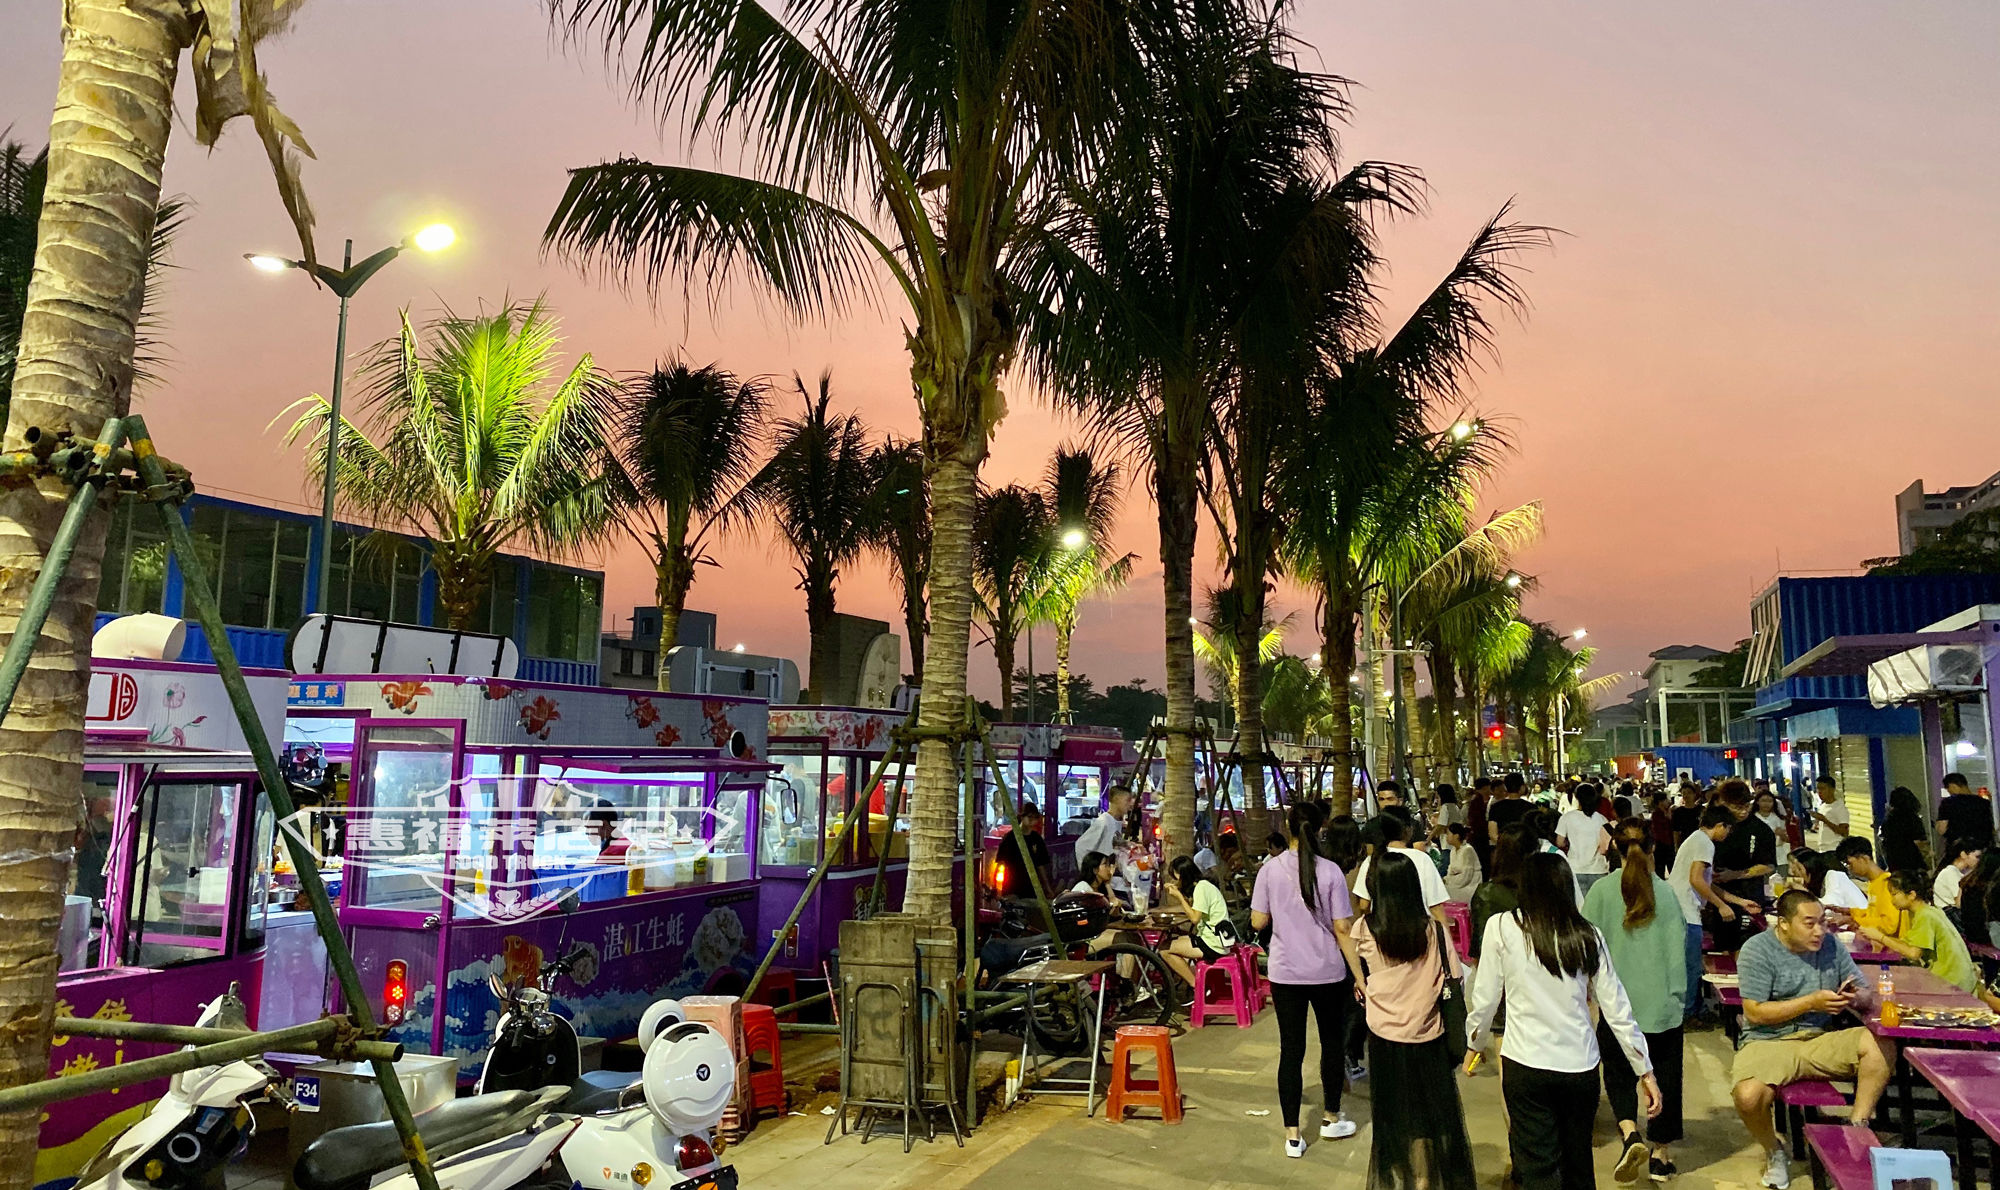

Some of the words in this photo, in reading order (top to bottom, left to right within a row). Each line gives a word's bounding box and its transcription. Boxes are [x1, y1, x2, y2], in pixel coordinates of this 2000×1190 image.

[602, 912, 685, 963] 湛江生蚝
[295, 1082, 318, 1098] F34
